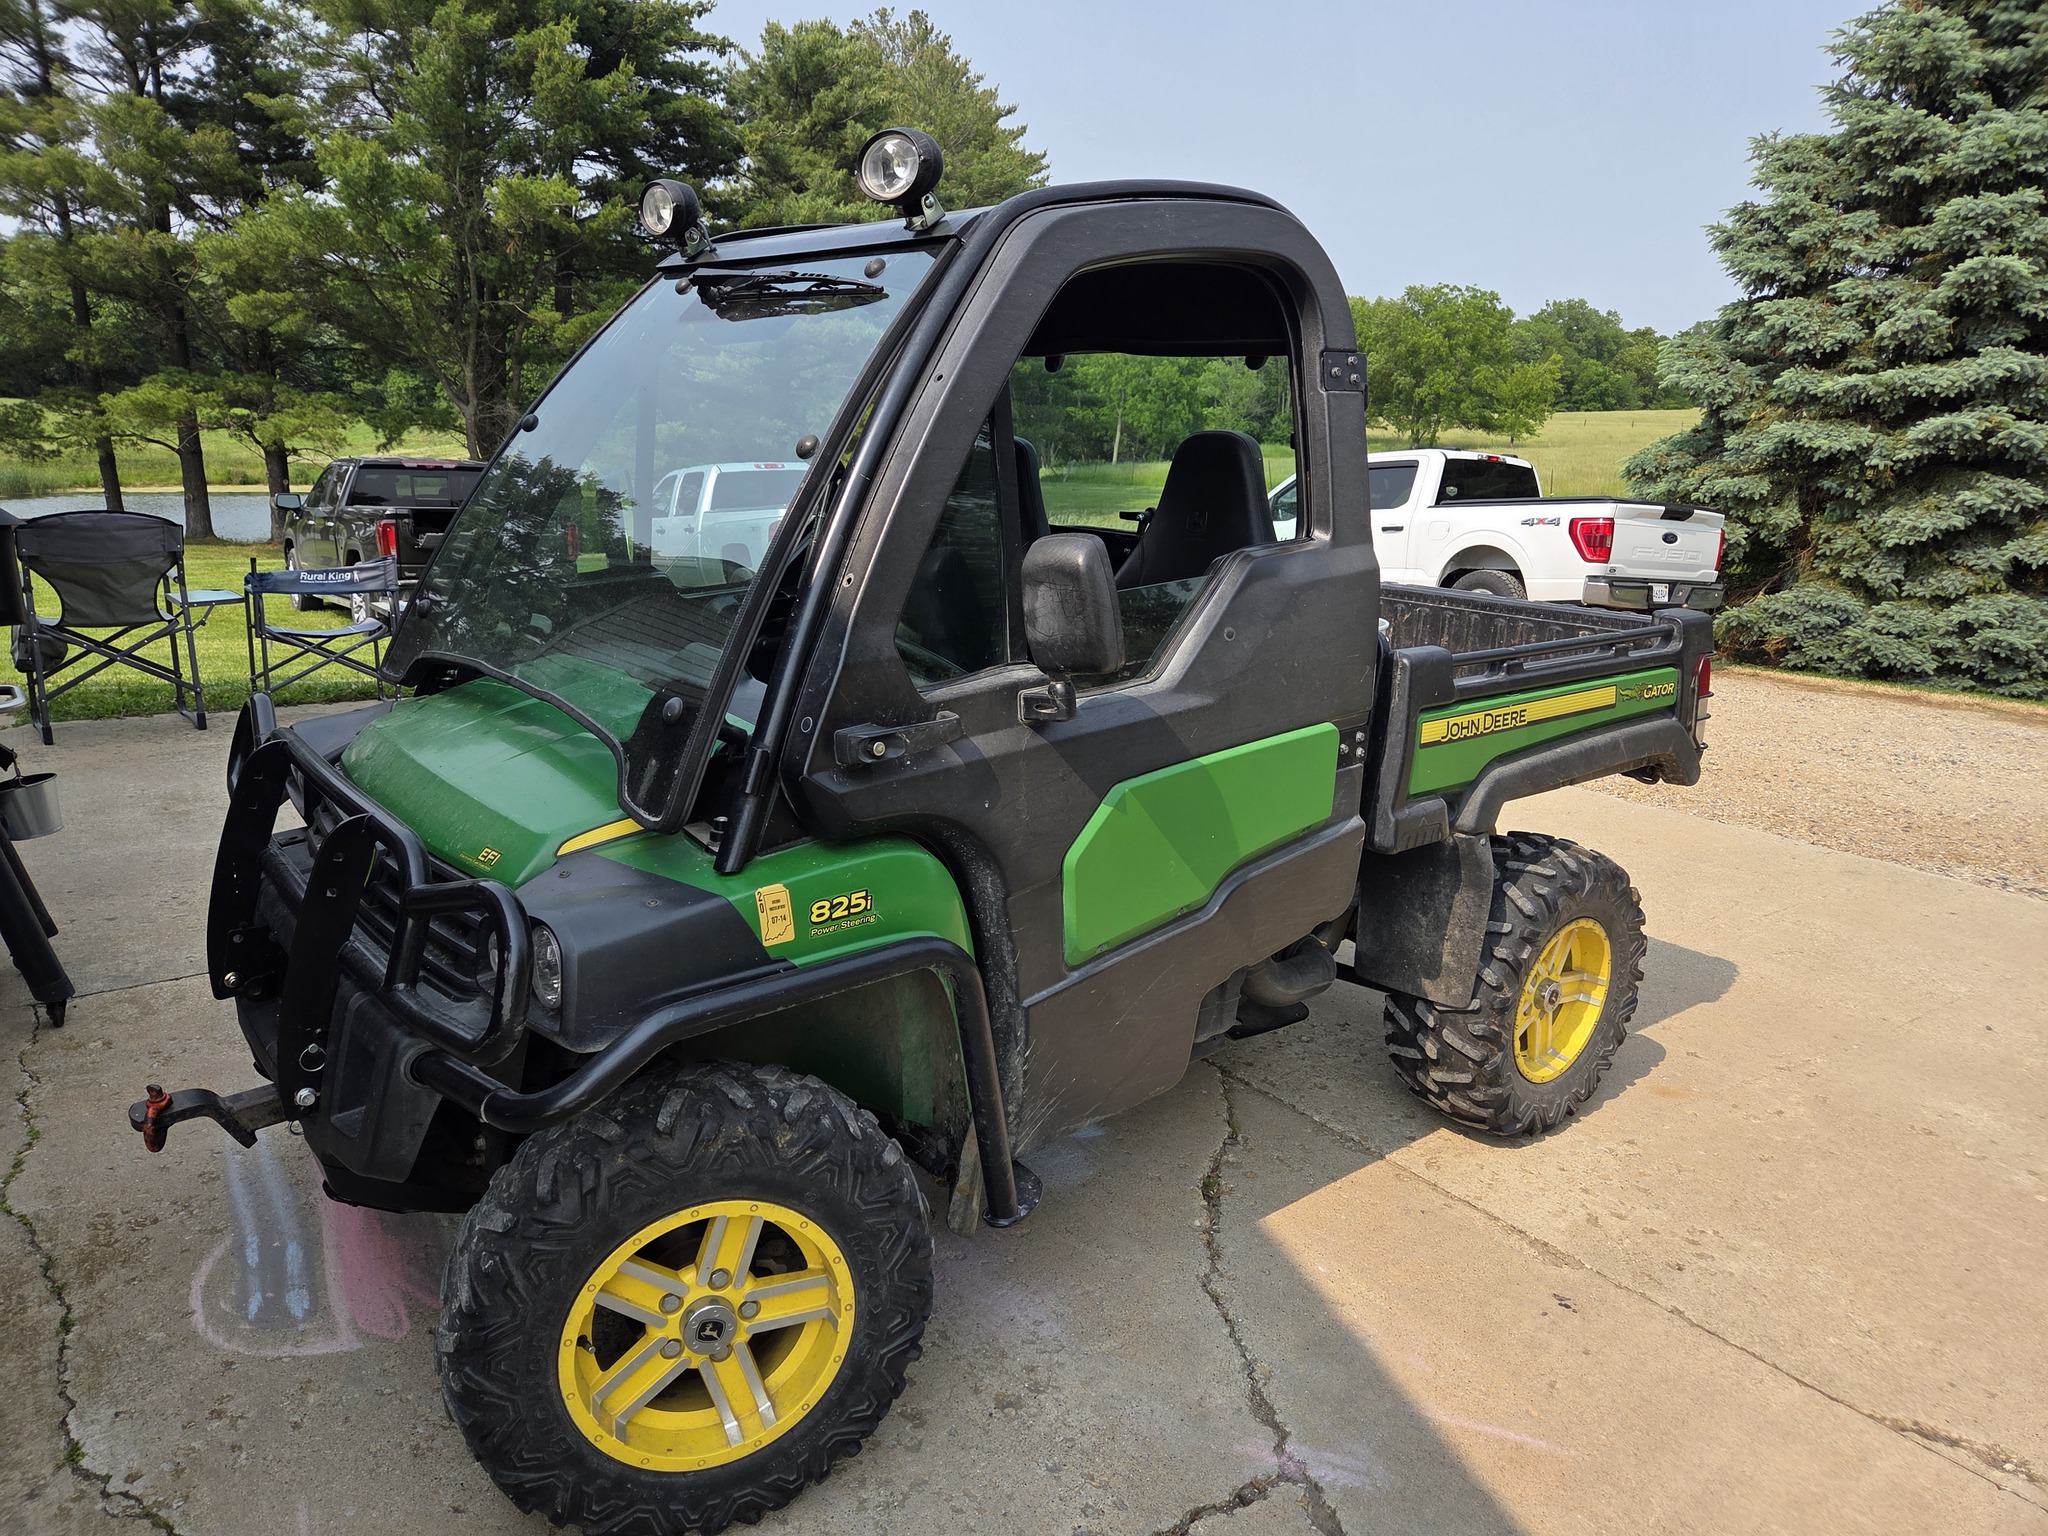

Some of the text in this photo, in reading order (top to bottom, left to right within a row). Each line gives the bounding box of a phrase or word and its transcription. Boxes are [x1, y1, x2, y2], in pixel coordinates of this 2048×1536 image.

[1631, 545, 1702, 563] F-150
[300, 571, 351, 581] Rural King
[1643, 683, 1675, 699] GATOR
[1440, 709, 1528, 740] JOHN DEERE
[477, 847, 502, 866] EFI
[810, 889, 873, 924] 825i
[810, 914, 876, 937] Power Steering
